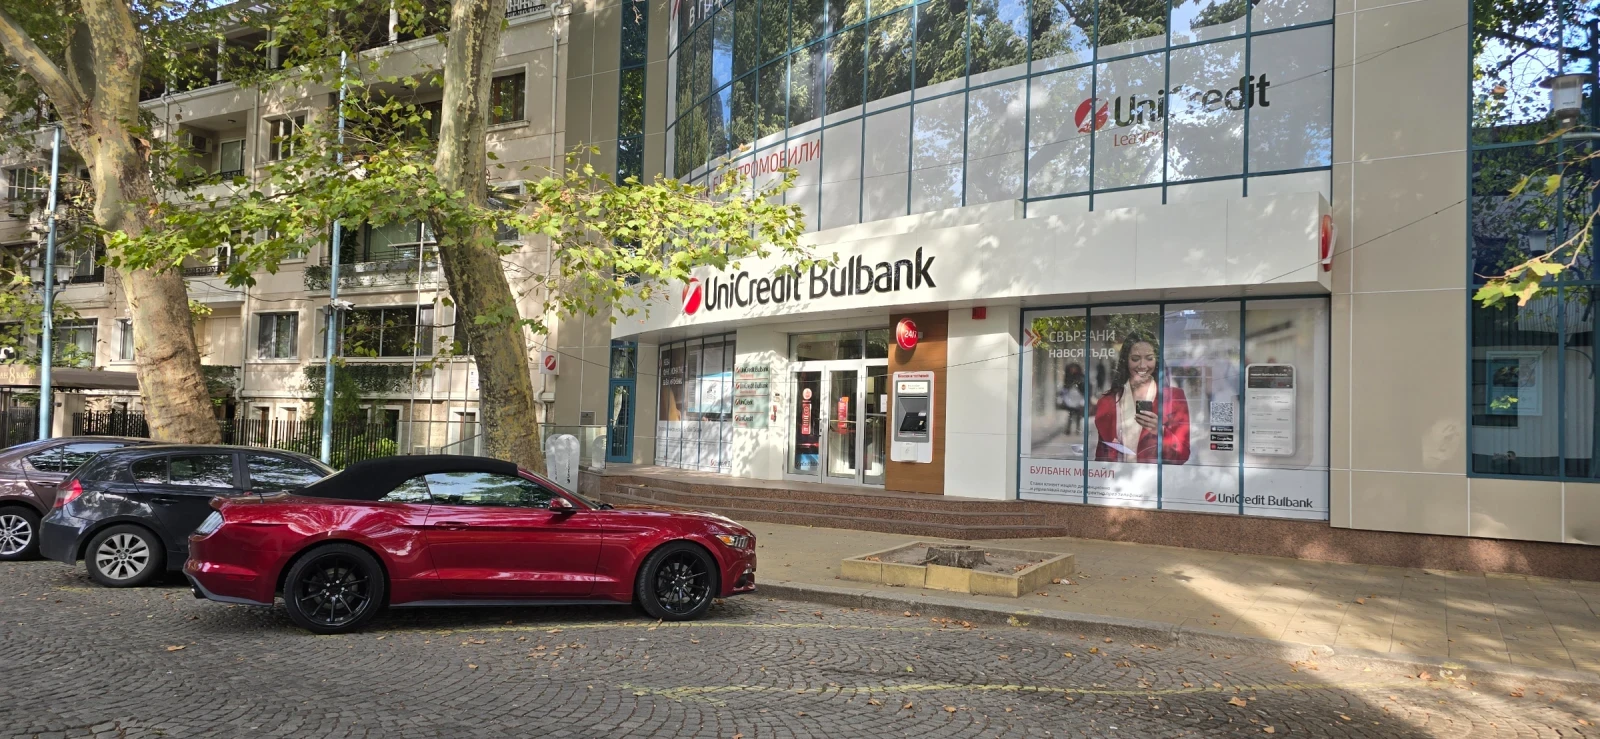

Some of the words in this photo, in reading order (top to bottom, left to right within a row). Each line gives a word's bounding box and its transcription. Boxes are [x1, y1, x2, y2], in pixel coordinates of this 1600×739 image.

[704, 265, 801, 312] UniCredit
[809, 246, 937, 299] Bulbank
[904, 329, 917, 339] 24/7
[1049, 330, 1116, 342] СВЪРЗАНИ
[1048, 347, 1116, 360] навсяъде
[1030, 466, 1071, 476] БУЛБАНК
[1267, 495, 1314, 508] Bulbank
